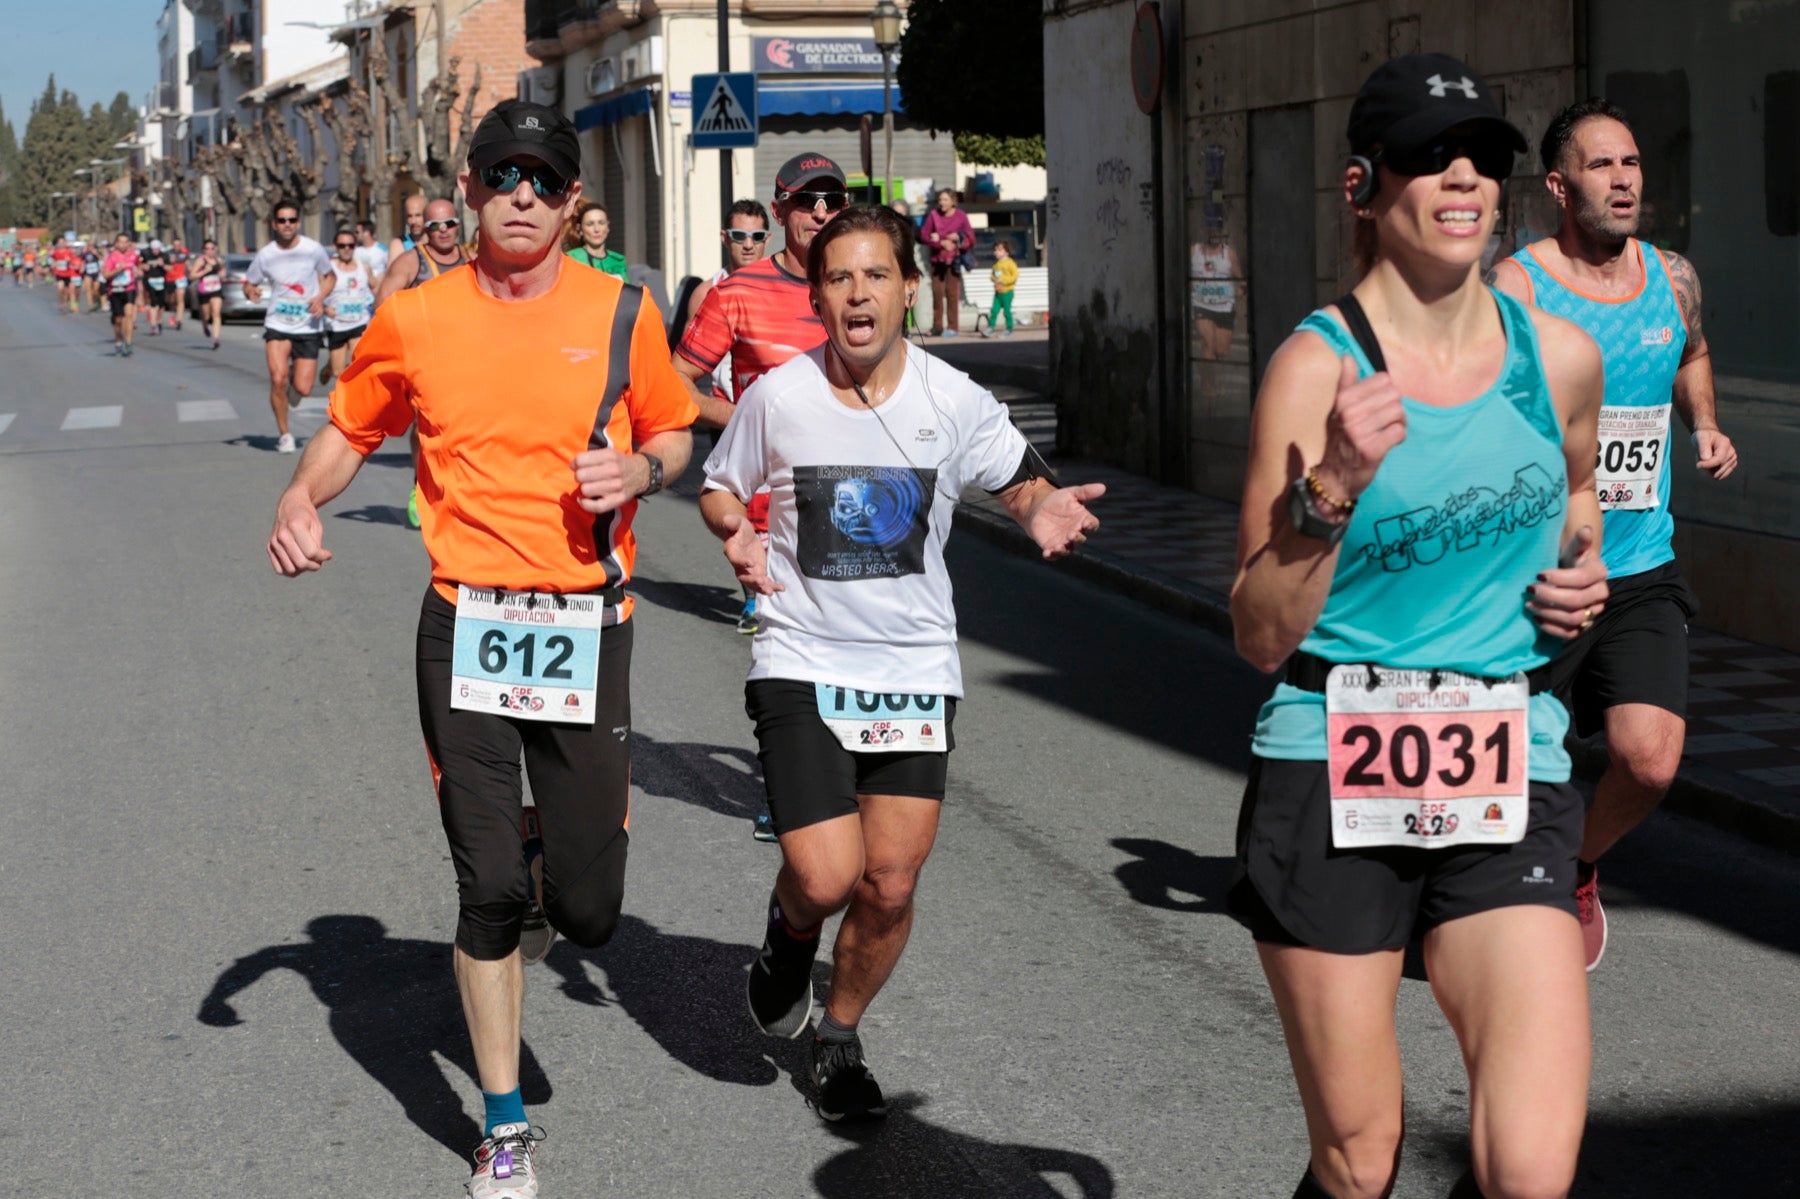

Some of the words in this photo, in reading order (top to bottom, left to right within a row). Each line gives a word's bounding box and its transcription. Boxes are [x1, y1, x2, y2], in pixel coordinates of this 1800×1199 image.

[795, 43, 863, 54] GRANADINA
[805, 53, 822, 64] DE
[1599, 410, 1618, 419] GRAN
[1620, 410, 1642, 420] PREMIO
[817, 465, 850, 479] IRON
[853, 466, 910, 481] MAIDEN
[820, 564, 862, 577] WASTED
[494, 592, 516, 607] RAN
[518, 595, 550, 610] PRMIO
[503, 609, 556, 623] DIPUTACIÓN
[478, 629, 575, 680] 612
[1379, 671, 1412, 688] GRAN
[1416, 671, 1460, 687] PRMIO
[1396, 691, 1470, 709] DIPUTACIÓN
[1341, 721, 1510, 788] 2031
